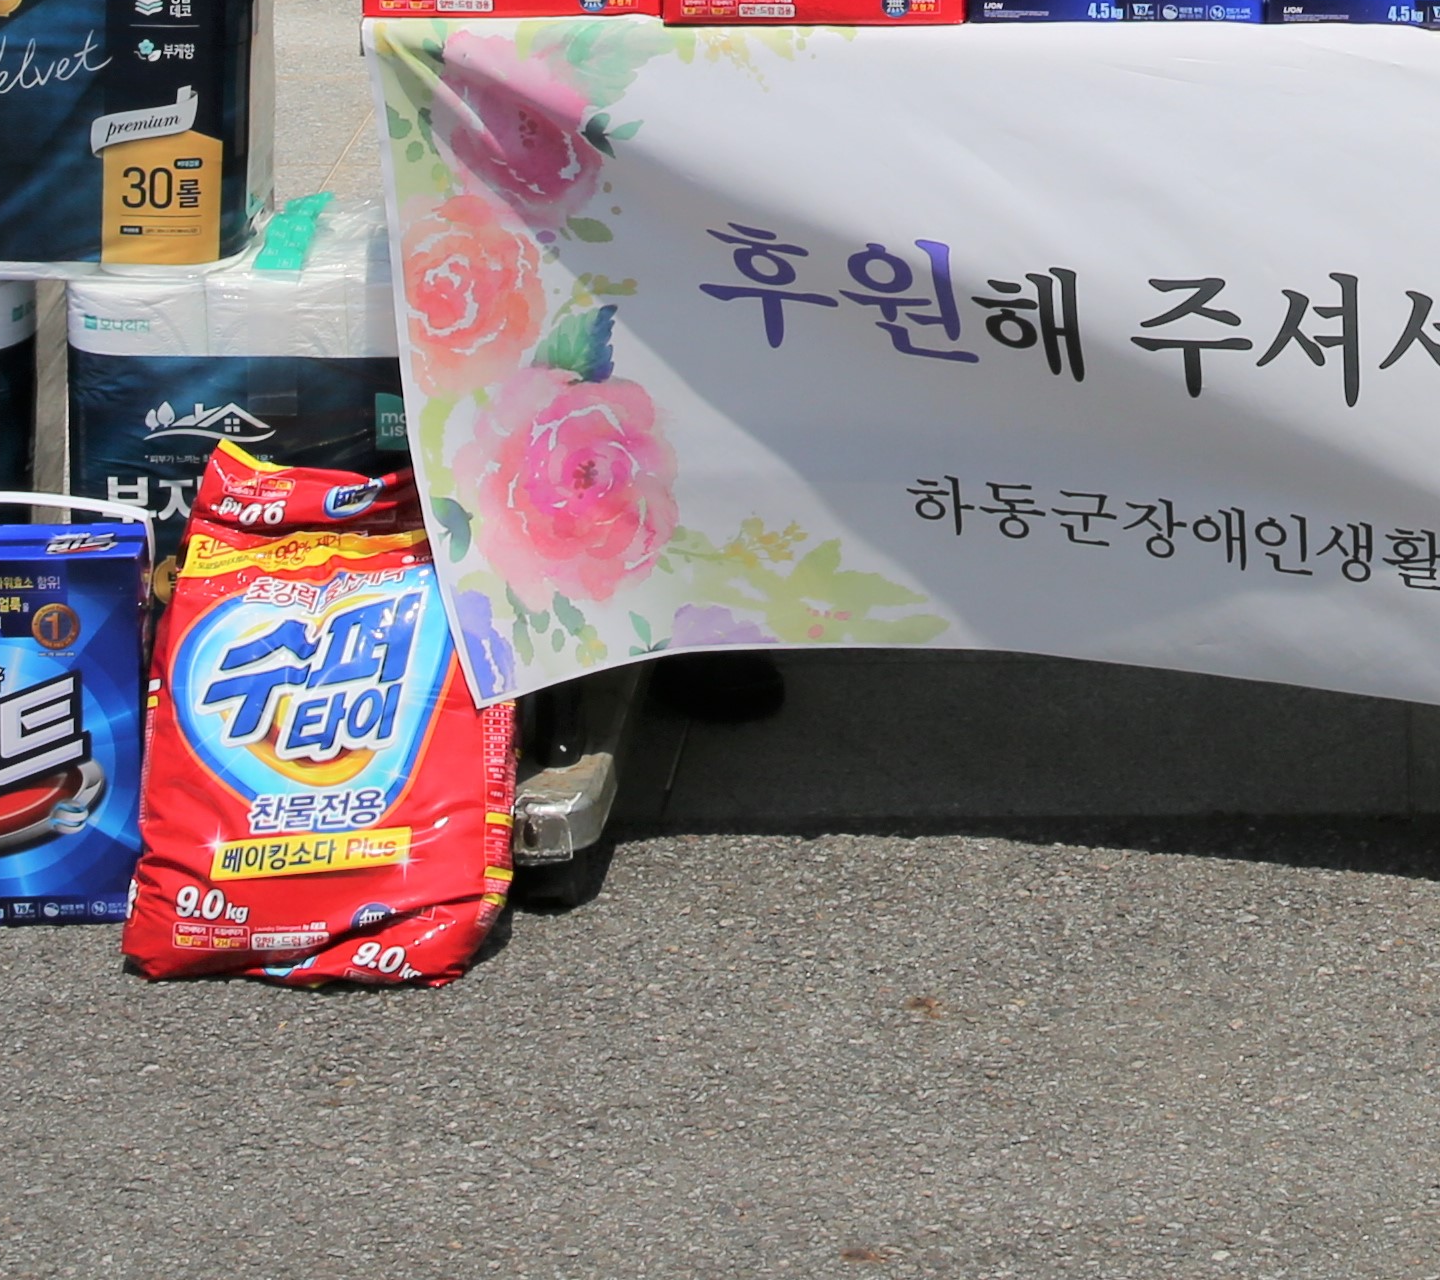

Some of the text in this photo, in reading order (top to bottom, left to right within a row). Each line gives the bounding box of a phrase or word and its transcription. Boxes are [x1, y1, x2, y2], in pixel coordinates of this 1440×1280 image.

[169, 5, 191, 18] 데코
[163, 43, 195, 59] 부케향
[105, 113, 181, 143] premium
[698, 220, 1085, 384] 후원해
[243, 577, 320, 613] 초강력
[203, 592, 424, 738] 수퍼
[285, 686, 396, 751] 타이
[249, 790, 385, 831] 찬물전용
[221, 837, 396, 873] 베이킹소다 Plus
